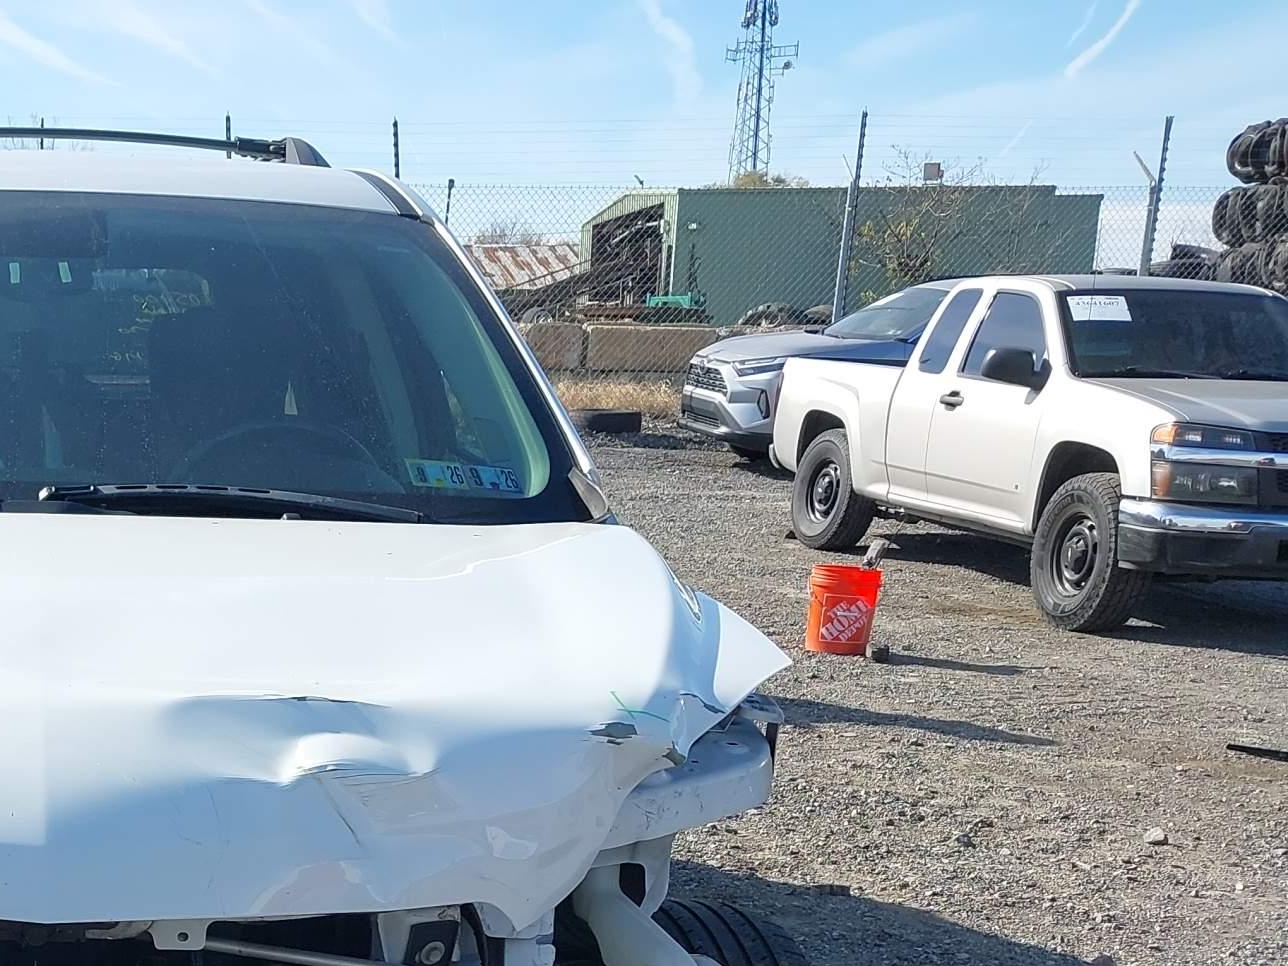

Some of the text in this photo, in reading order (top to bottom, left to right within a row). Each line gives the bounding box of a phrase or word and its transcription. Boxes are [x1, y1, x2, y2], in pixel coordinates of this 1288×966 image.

[446, 465, 465, 484] 26
[501, 469, 519, 488] 26
[821, 600, 867, 641] HOME
